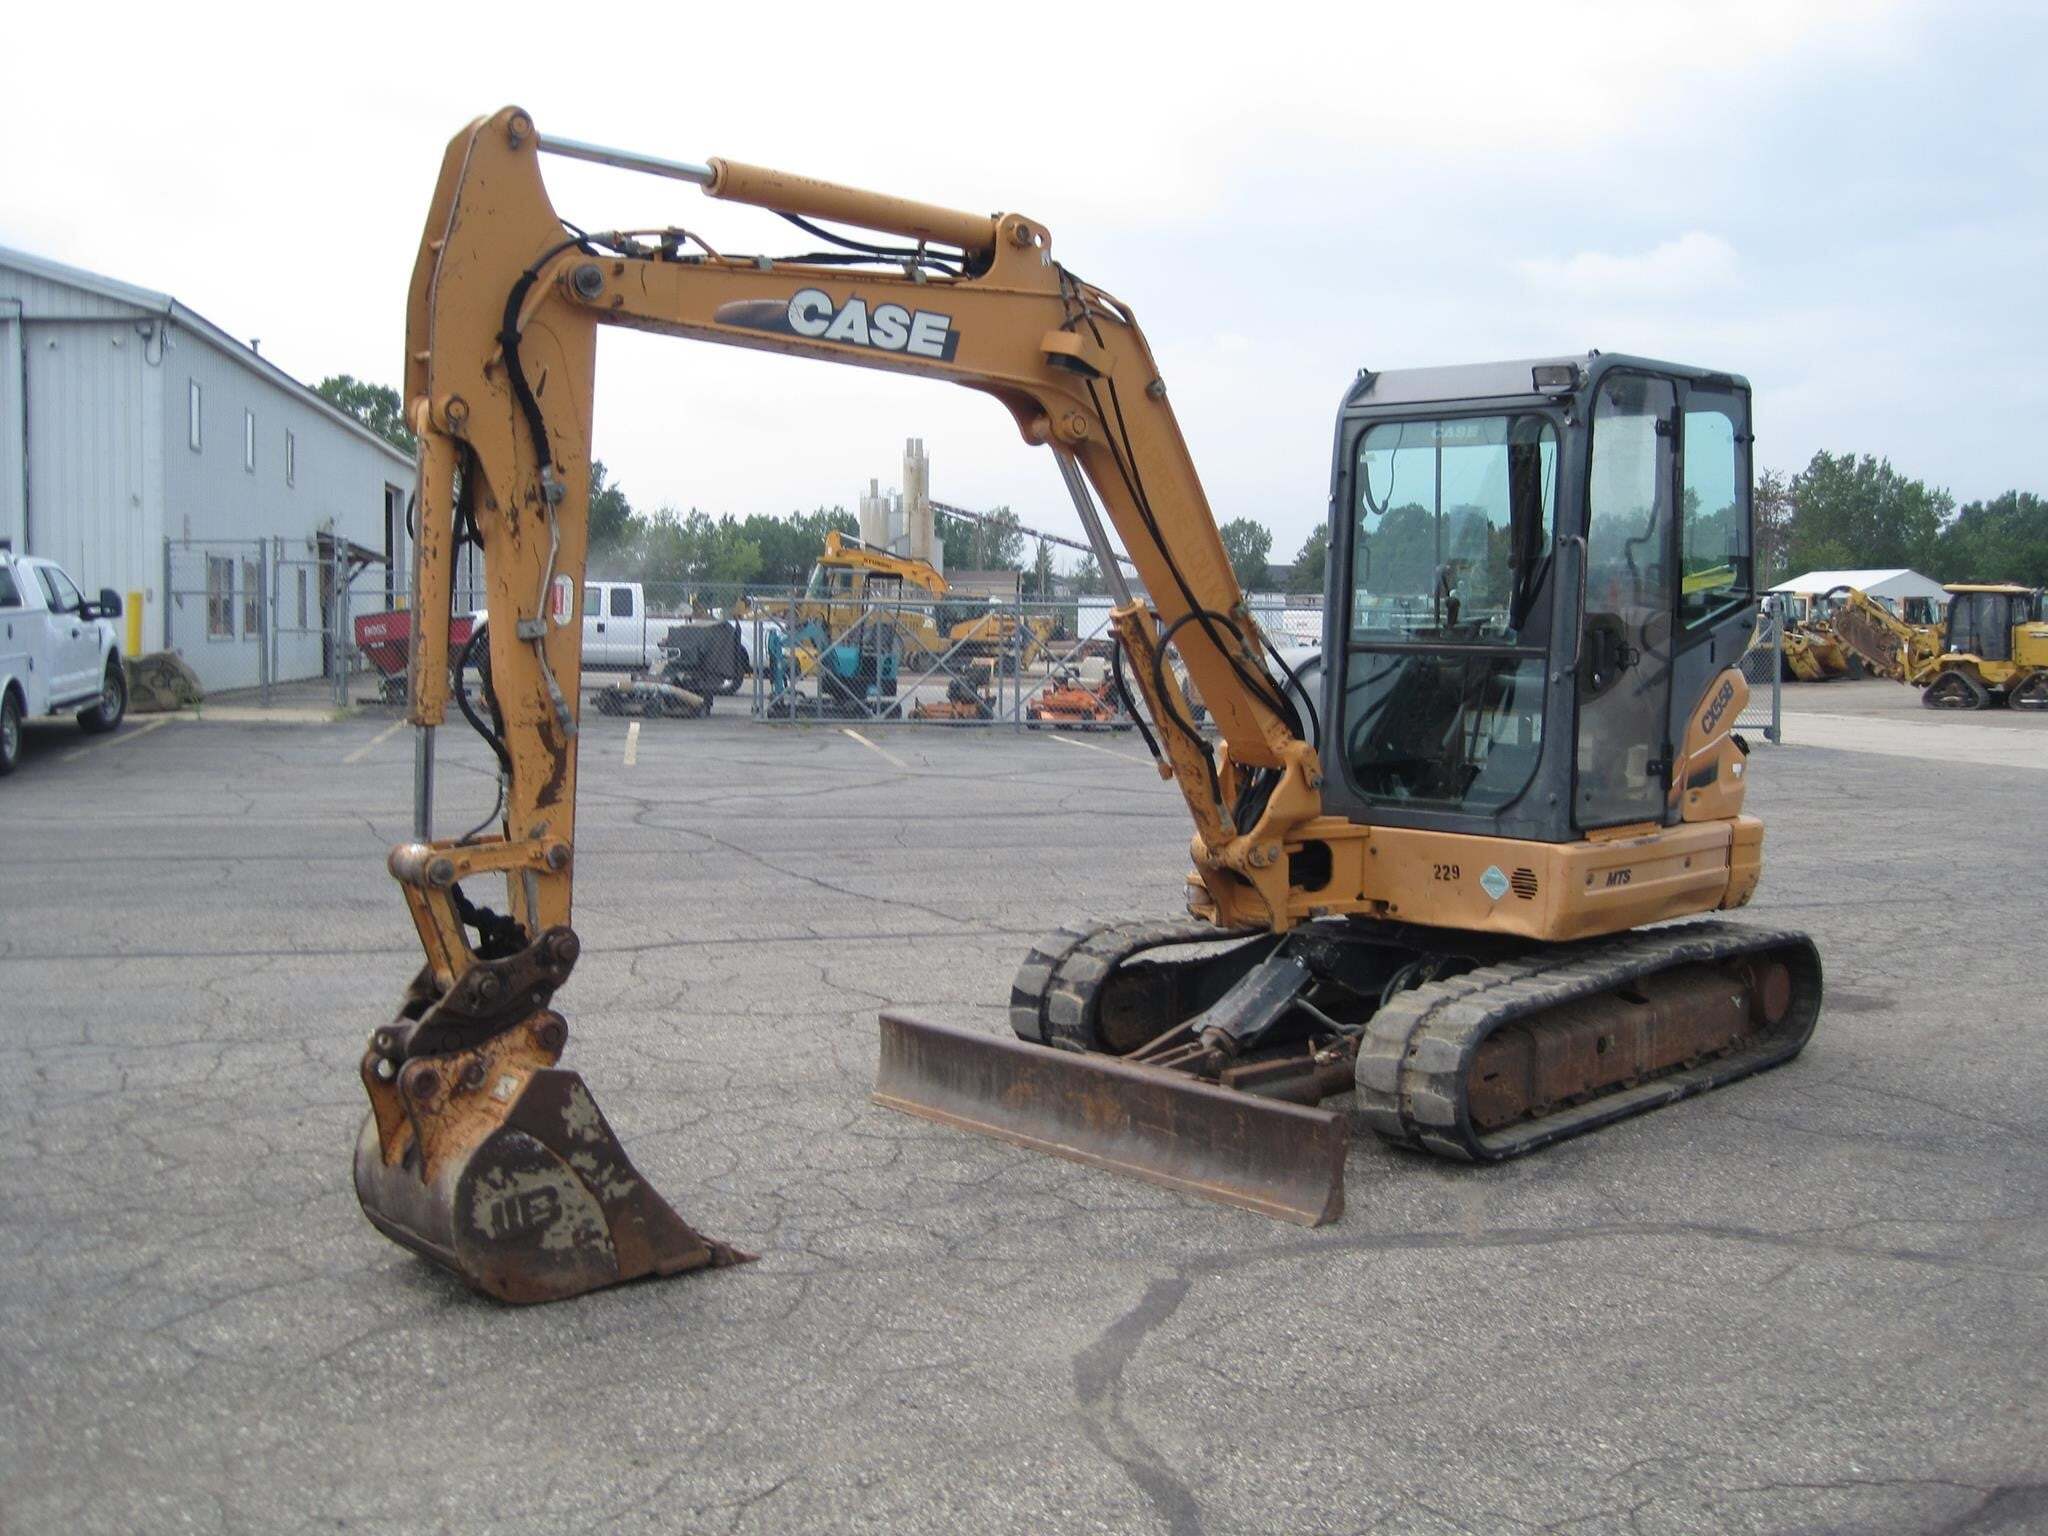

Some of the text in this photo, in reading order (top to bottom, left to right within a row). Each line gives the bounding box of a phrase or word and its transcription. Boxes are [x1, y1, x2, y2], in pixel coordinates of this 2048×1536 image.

[788, 288, 951, 357] CASE
[1431, 425, 1479, 440] CASE
[1433, 864, 1461, 881] 229
